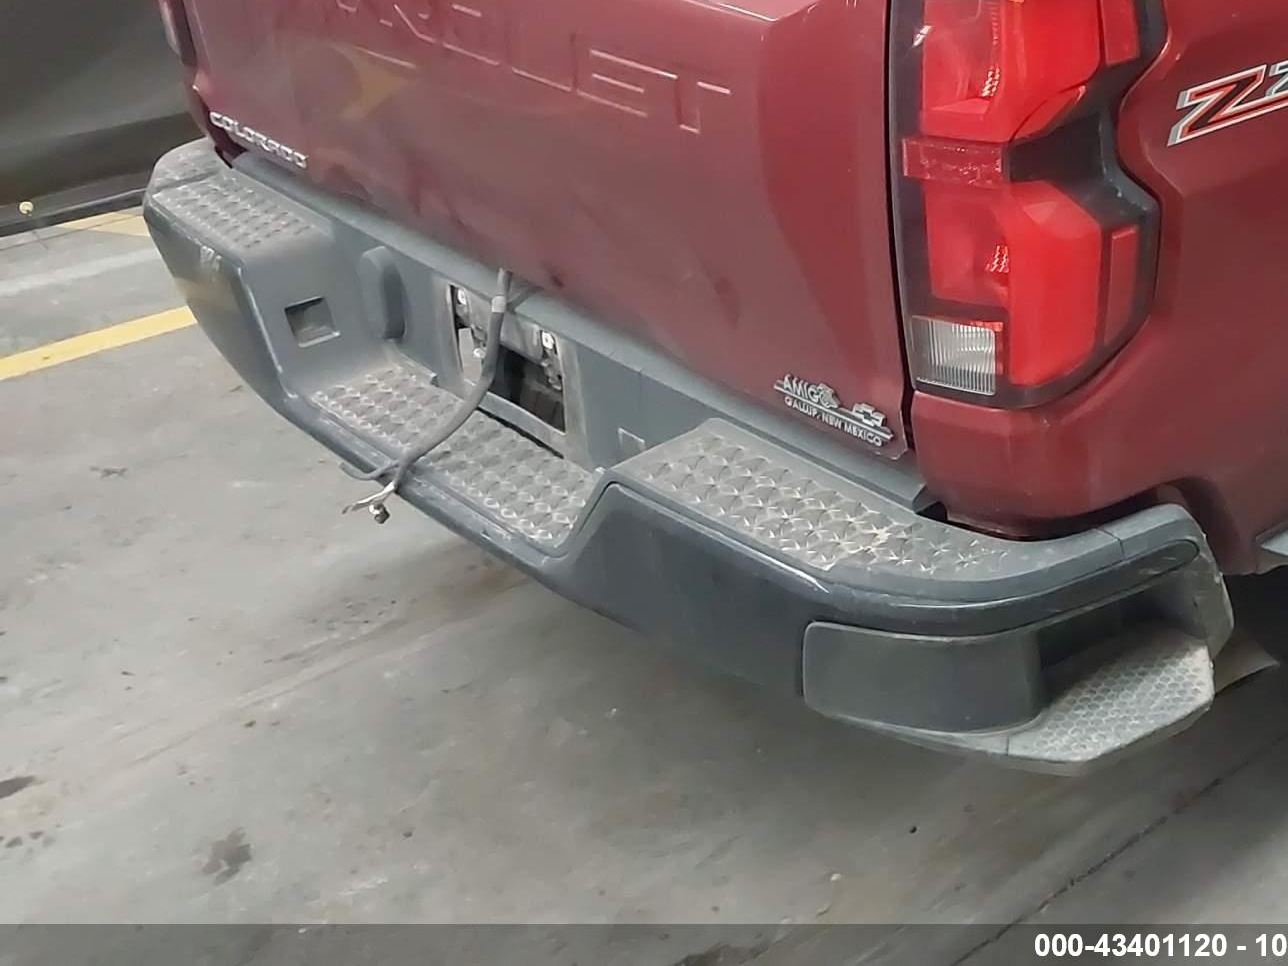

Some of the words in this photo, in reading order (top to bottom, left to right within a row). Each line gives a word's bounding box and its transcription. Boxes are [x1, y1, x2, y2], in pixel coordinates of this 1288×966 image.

[210, 112, 308, 169] COLORADO
[822, 412, 845, 429] NEW
[845, 421, 882, 447] MEXICO
